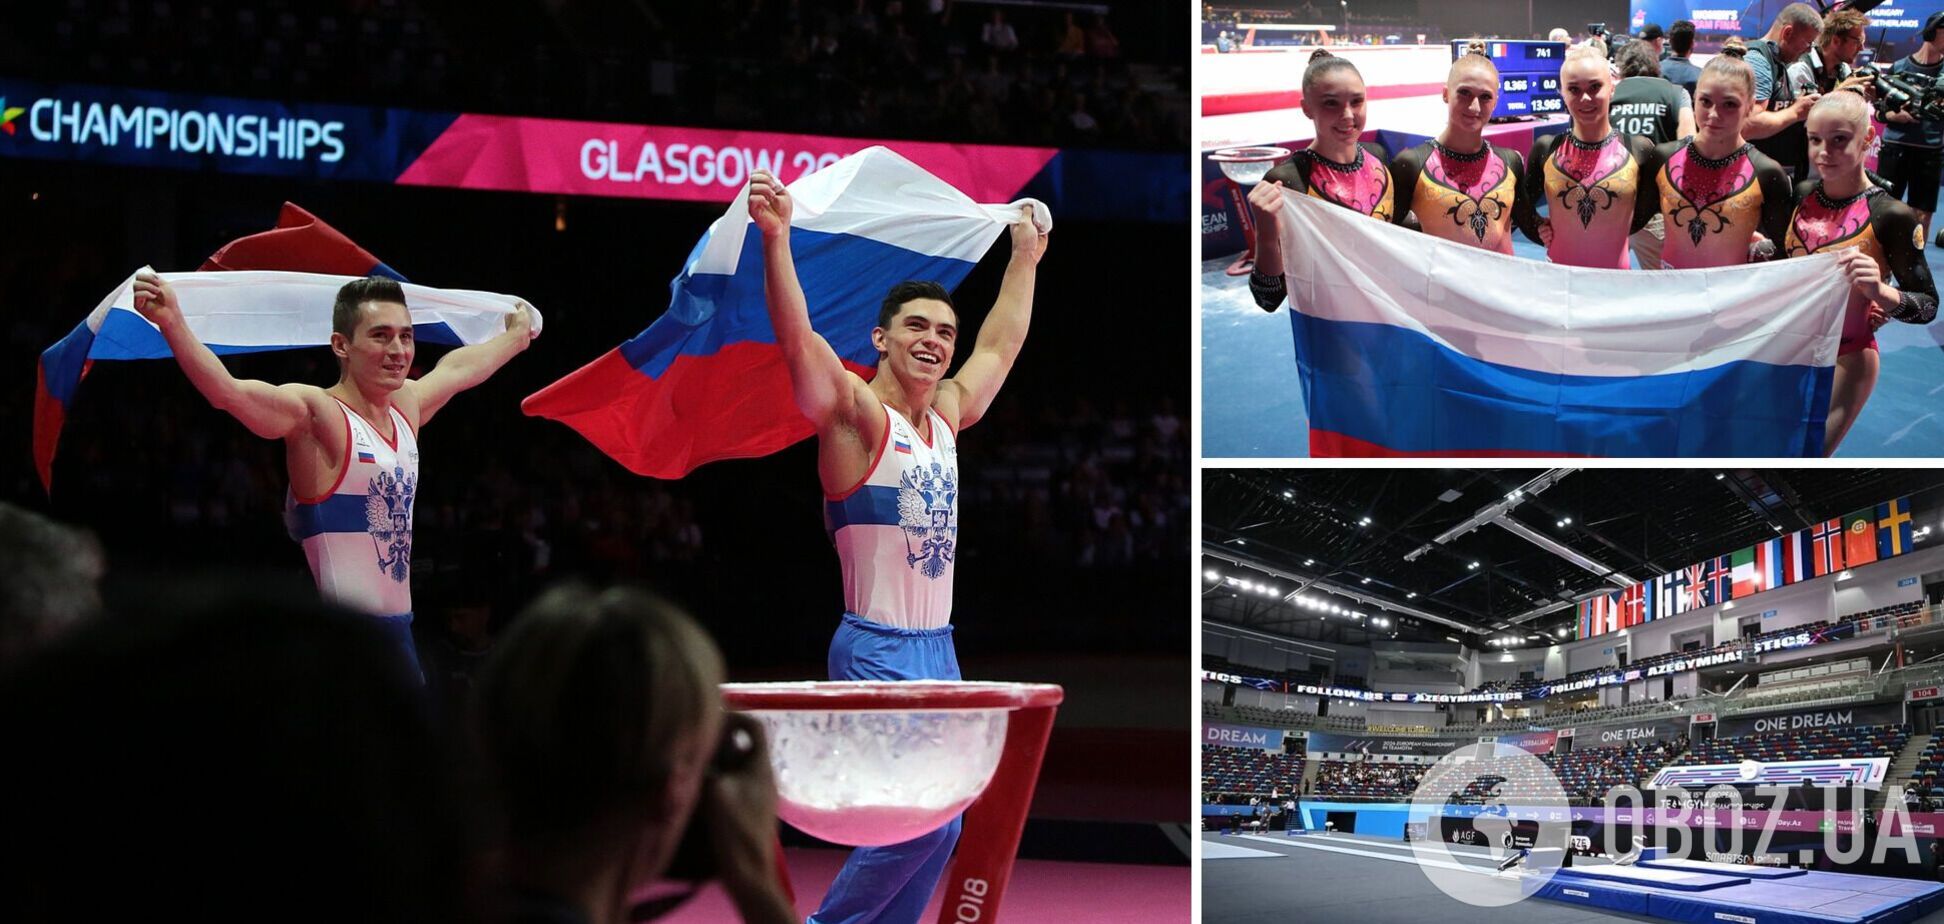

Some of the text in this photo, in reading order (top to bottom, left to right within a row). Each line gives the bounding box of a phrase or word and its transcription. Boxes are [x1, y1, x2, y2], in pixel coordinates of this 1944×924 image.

[1714, 20, 1741, 30] FINAL
[1536, 48, 1551, 58] 741
[1543, 80, 1557, 89] 0.0
[1611, 103, 1667, 116] PRIME
[29, 97, 345, 163] CHAMPIONSHIPS
[1616, 118, 1654, 134] 105
[580, 138, 784, 188] GLASGOW
[1201, 671, 1243, 685] TICS
[1550, 678, 1597, 695] FOLLOW
[1598, 674, 1617, 686] US
[1297, 684, 1361, 699] FOLLOW
[1754, 710, 1853, 732] ONE DREAM
[1207, 726, 1267, 745] DREAM
[1601, 727, 1656, 742] ONE TEAM
[1460, 831, 1476, 841] AGF
[953, 878, 988, 924] 018
